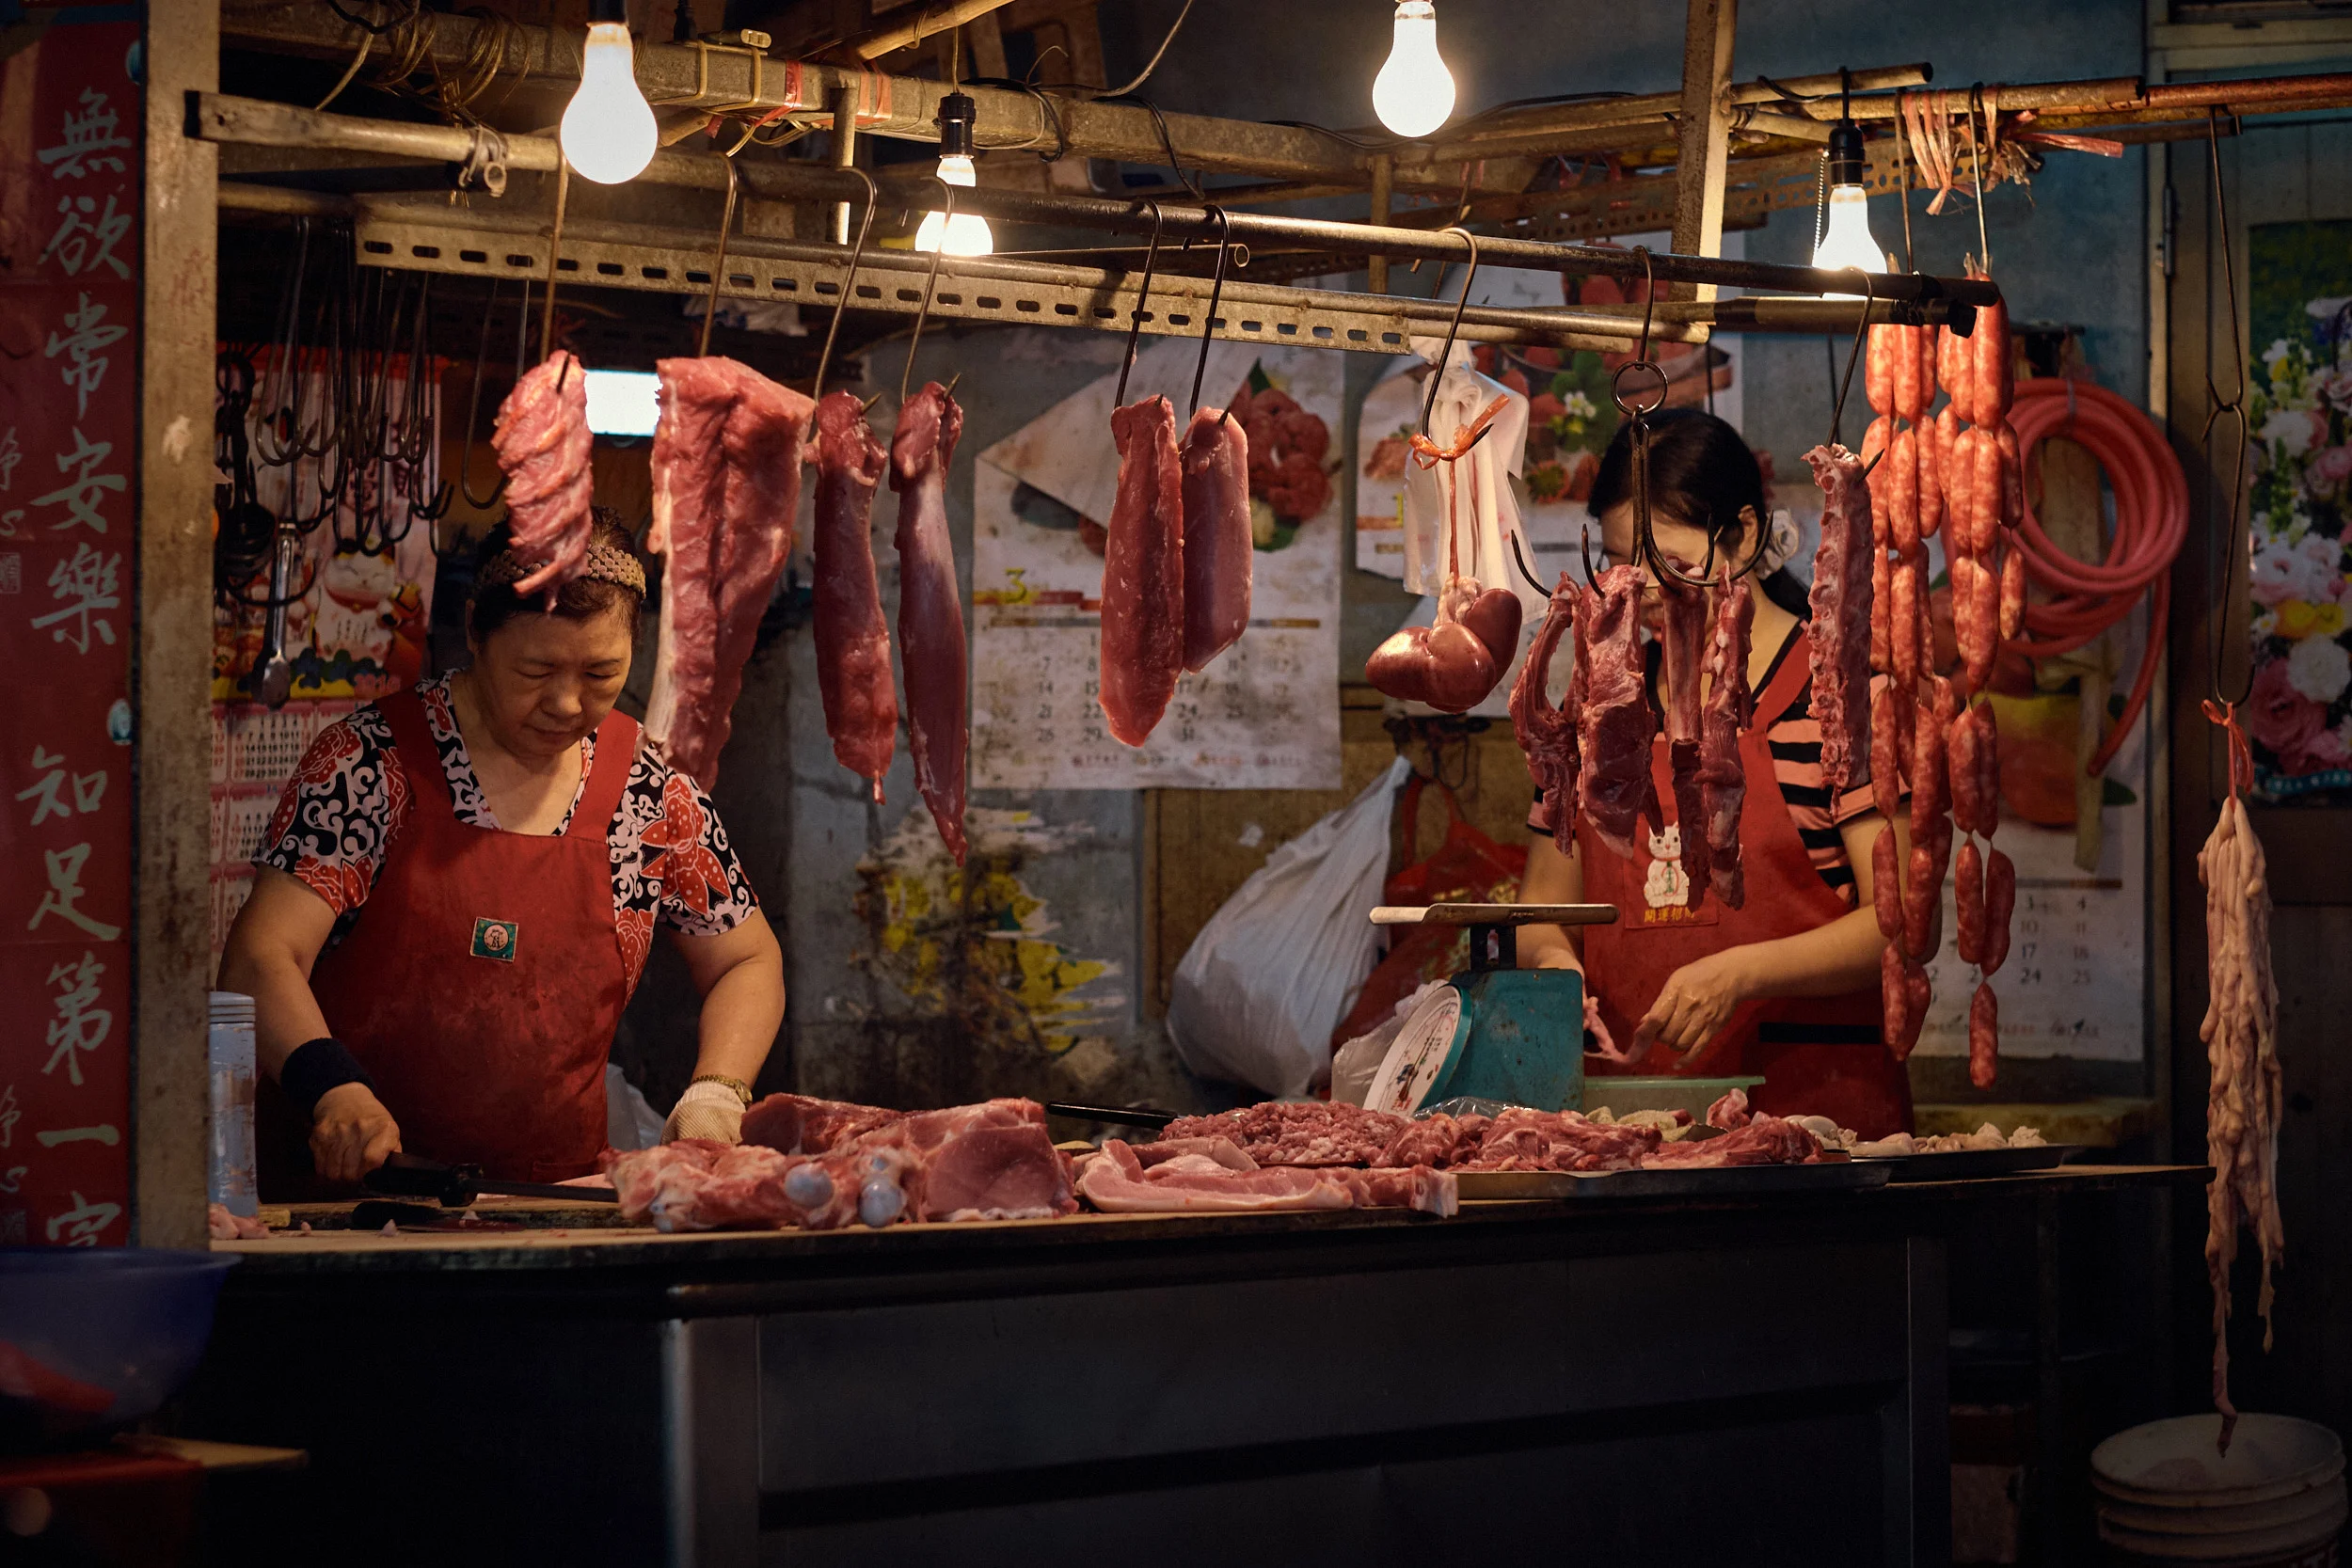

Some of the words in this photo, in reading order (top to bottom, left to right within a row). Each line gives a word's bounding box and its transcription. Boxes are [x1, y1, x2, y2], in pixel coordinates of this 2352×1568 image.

[30, 87, 132, 656] 無欲常安樂
[1005, 567, 1027, 604] 3
[2022, 942, 2038, 959] 17
[2020, 967, 2042, 985] 24
